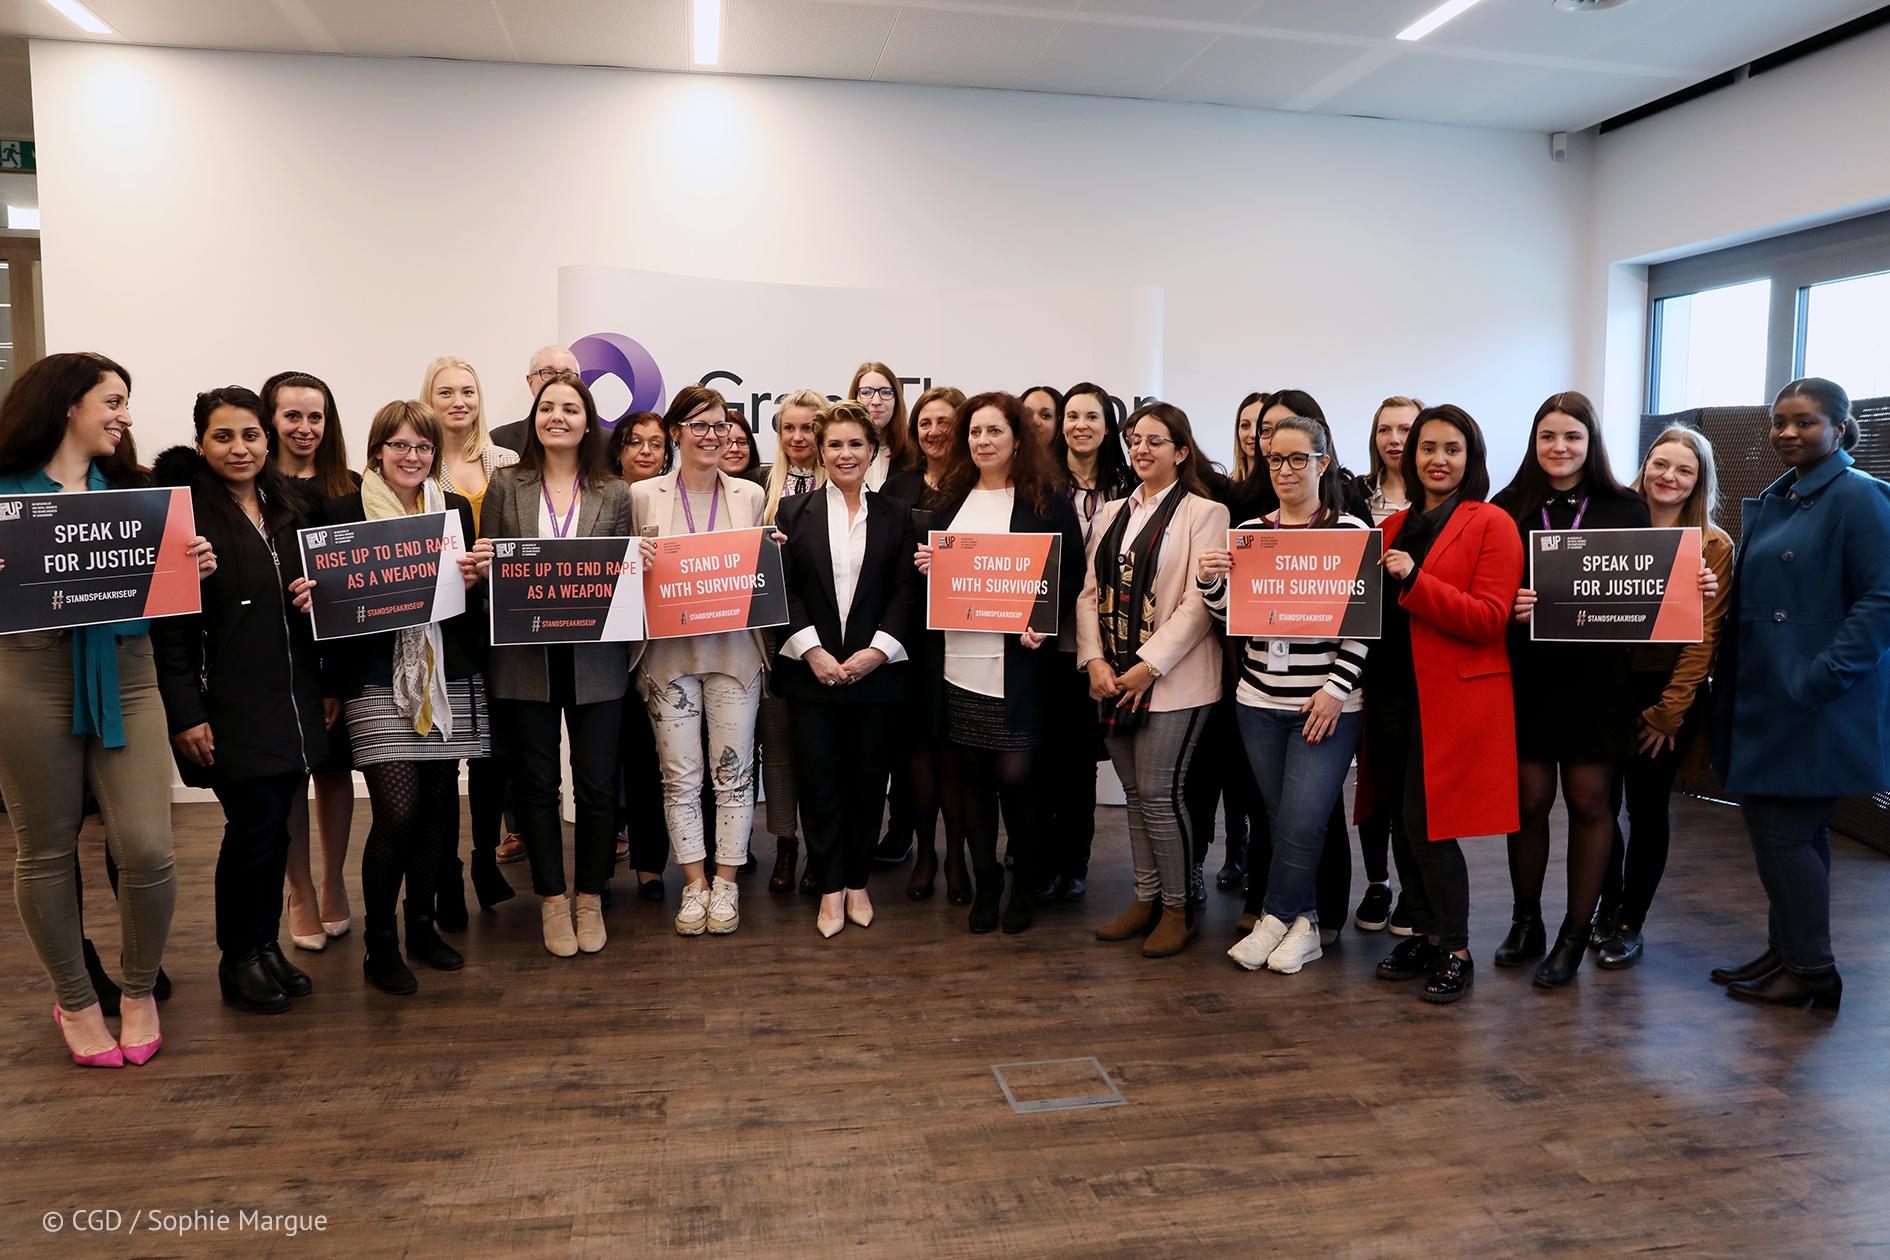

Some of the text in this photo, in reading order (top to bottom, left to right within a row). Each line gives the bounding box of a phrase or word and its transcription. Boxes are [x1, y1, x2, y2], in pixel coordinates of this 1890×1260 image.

[54, 520, 142, 544] SPEAK UP
[44, 547, 156, 573] FOR JUSTICE
[315, 535, 458, 570] RISE UP TO END RAPE
[502, 561, 636, 578] RISE UP TO END RAPE
[680, 553, 741, 574] STAND UP
[973, 556, 1031, 572] STAND UP
[1275, 555, 1341, 571] STAND UP
[1583, 555, 1654, 572] SPEAK UP
[347, 561, 437, 590] AS A WEAPON
[527, 583, 612, 599] AS A WEAPON
[659, 573, 766, 599] WITH SURVIVORS
[951, 577, 1048, 595] WITH SURVIVORS
[1251, 579, 1365, 596] WITH SURVIVORS
[1573, 579, 1664, 596] FOR JUSTICE
[52, 589, 137, 610] #STANDSPEAKRISEUP
[356, 601, 424, 623] #STANDSPEAKRISEUP
[1576, 610, 1647, 627] #STANDSPEAKRISEUP
[531, 616, 596, 632] #STANDSPEAKRISEUP
